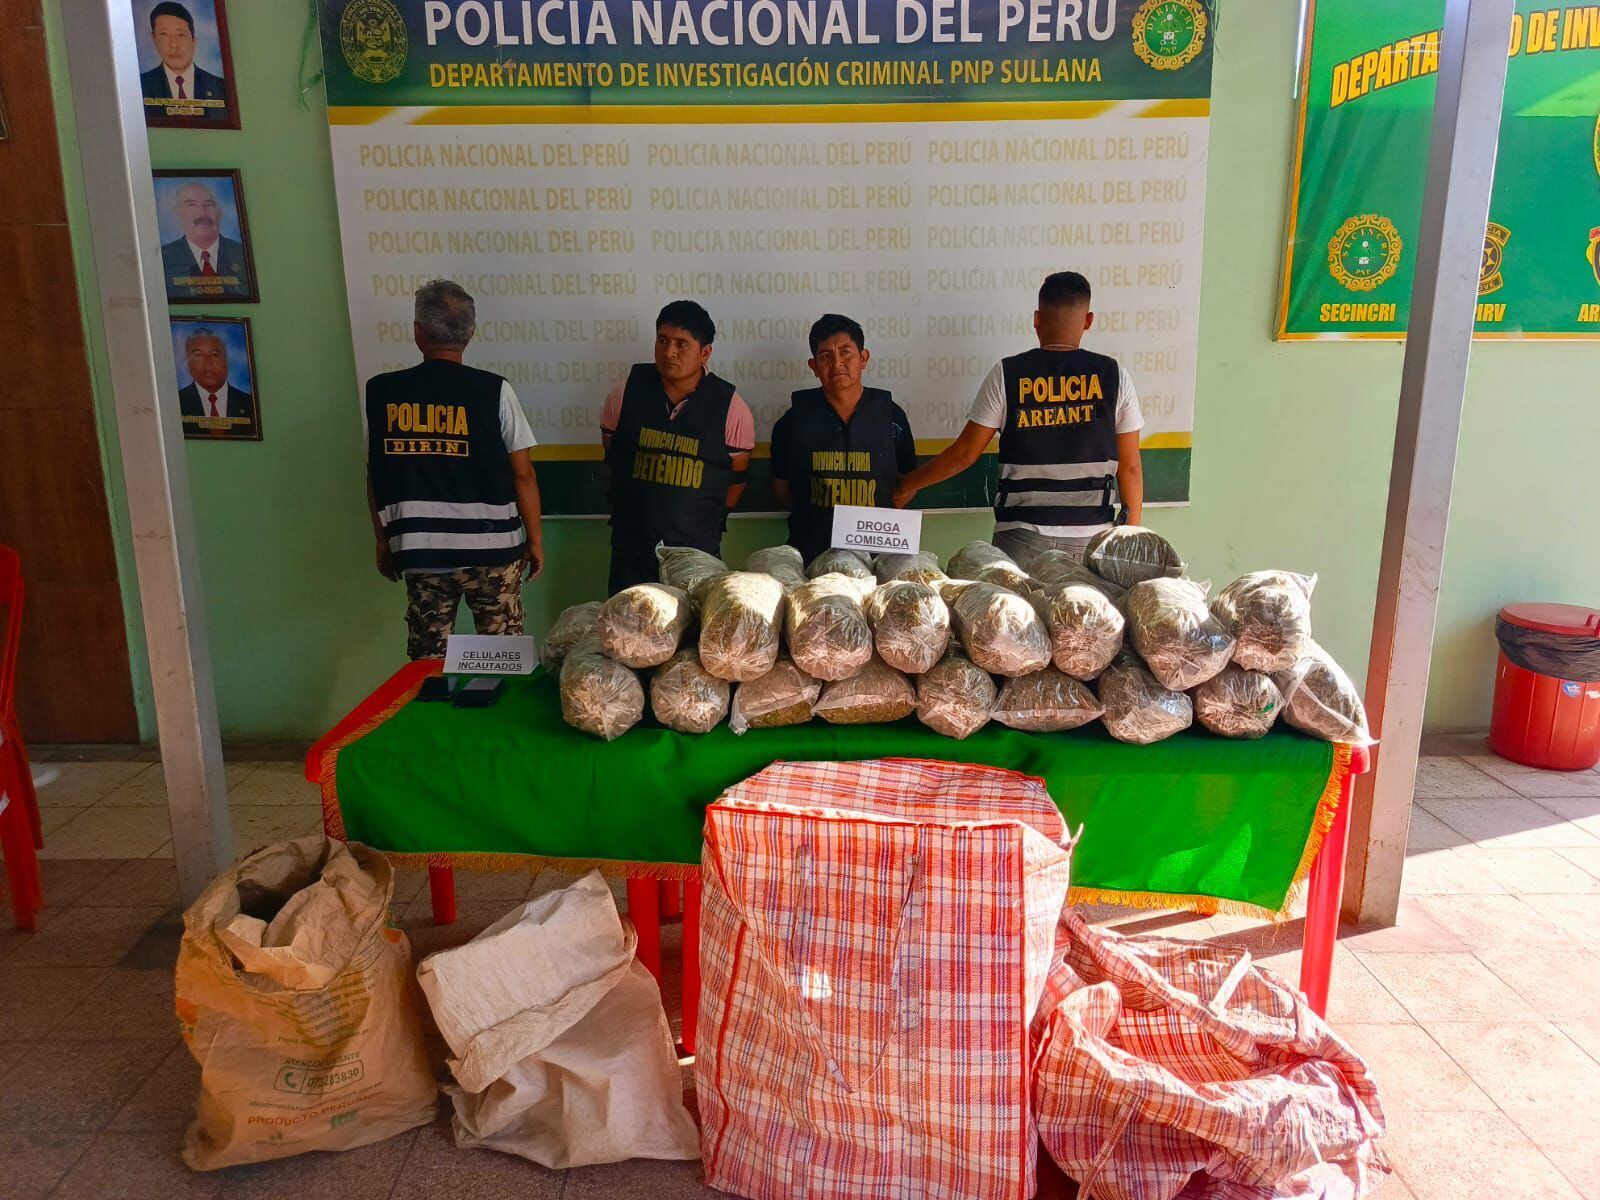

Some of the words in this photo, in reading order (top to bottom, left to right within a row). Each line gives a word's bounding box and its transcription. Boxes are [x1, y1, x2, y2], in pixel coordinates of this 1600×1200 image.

[632, 0, 880, 46] NACIONAL
[896, 0, 983, 44] DEL
[1147, 4, 1193, 30] DIRINCRI
[430, 62, 613, 87] DEPARTAMENTO
[620, 62, 650, 87] DE
[656, 57, 829, 87] INVESTIGACIÓN
[836, 61, 944, 86] CRIMINAL
[951, 60, 994, 84] PNP
[1001, 58, 1102, 83] SULLANA
[1330, 29, 1443, 109] DEPARTA
[1526, 9, 1560, 54] DE
[359, 144, 434, 168] POLICIA
[440, 144, 538, 167] NACIONAL
[542, 143, 578, 167] DEL
[583, 138, 630, 166] PERÚ
[648, 144, 720, 166] POLICIA
[726, 144, 820, 166] NACIONAL
[826, 143, 860, 166] DEL
[865, 137, 912, 164] PERÚ
[928, 140, 999, 164] POLICIA
[1006, 138, 1098, 162] NACIONAL
[1104, 136, 1138, 160] DEL
[1144, 132, 1189, 159] PERÚ
[364, 188, 439, 212] POLICIA
[444, 188, 540, 211] NACIONAL
[545, 188, 580, 210] DEL
[585, 184, 632, 210] PERÚ
[650, 187, 722, 210] POLICIA
[728, 187, 821, 210] NACIONAL
[828, 187, 860, 208] DEL
[866, 181, 912, 208] PERÚ
[928, 184, 999, 207] POLICIA
[1004, 181, 1098, 205] NACIONAL
[1103, 180, 1136, 204] DEL
[1142, 175, 1187, 202] PERÚ
[368, 232, 442, 254] POLICIA
[447, 231, 544, 252] NACIONAL
[549, 230, 582, 252] DEL
[588, 226, 634, 252] PERÚ
[653, 230, 723, 252] POLICIA
[730, 229, 821, 250] NACIONAL
[828, 228, 860, 250] DEL
[866, 223, 912, 250] PERÚ
[928, 226, 998, 248] POLICIA
[1003, 223, 1095, 248] NACIONAL
[1102, 222, 1133, 245] DEL
[1140, 217, 1184, 244] PERÚ
[552, 274, 585, 295] DEL
[654, 273, 725, 294] POLICIA
[731, 272, 822, 294] NACIONAL
[829, 271, 860, 292] DEL
[928, 268, 996, 291] POLICIA
[1100, 265, 1131, 287] DEL
[1320, 303, 1396, 322] SECINCRI
[1017, 404, 1094, 428] AREANT
[393, 441, 459, 453] DIRIN
[632, 451, 704, 489] DETENIDO
[845, 533, 910, 548] COMISADA
[856, 520, 900, 533] DROGA
[458, 661, 523, 670] INCAUTADOS
[462, 651, 521, 660] CELULARES
[247, 1110, 319, 1127] PRODUCTO
